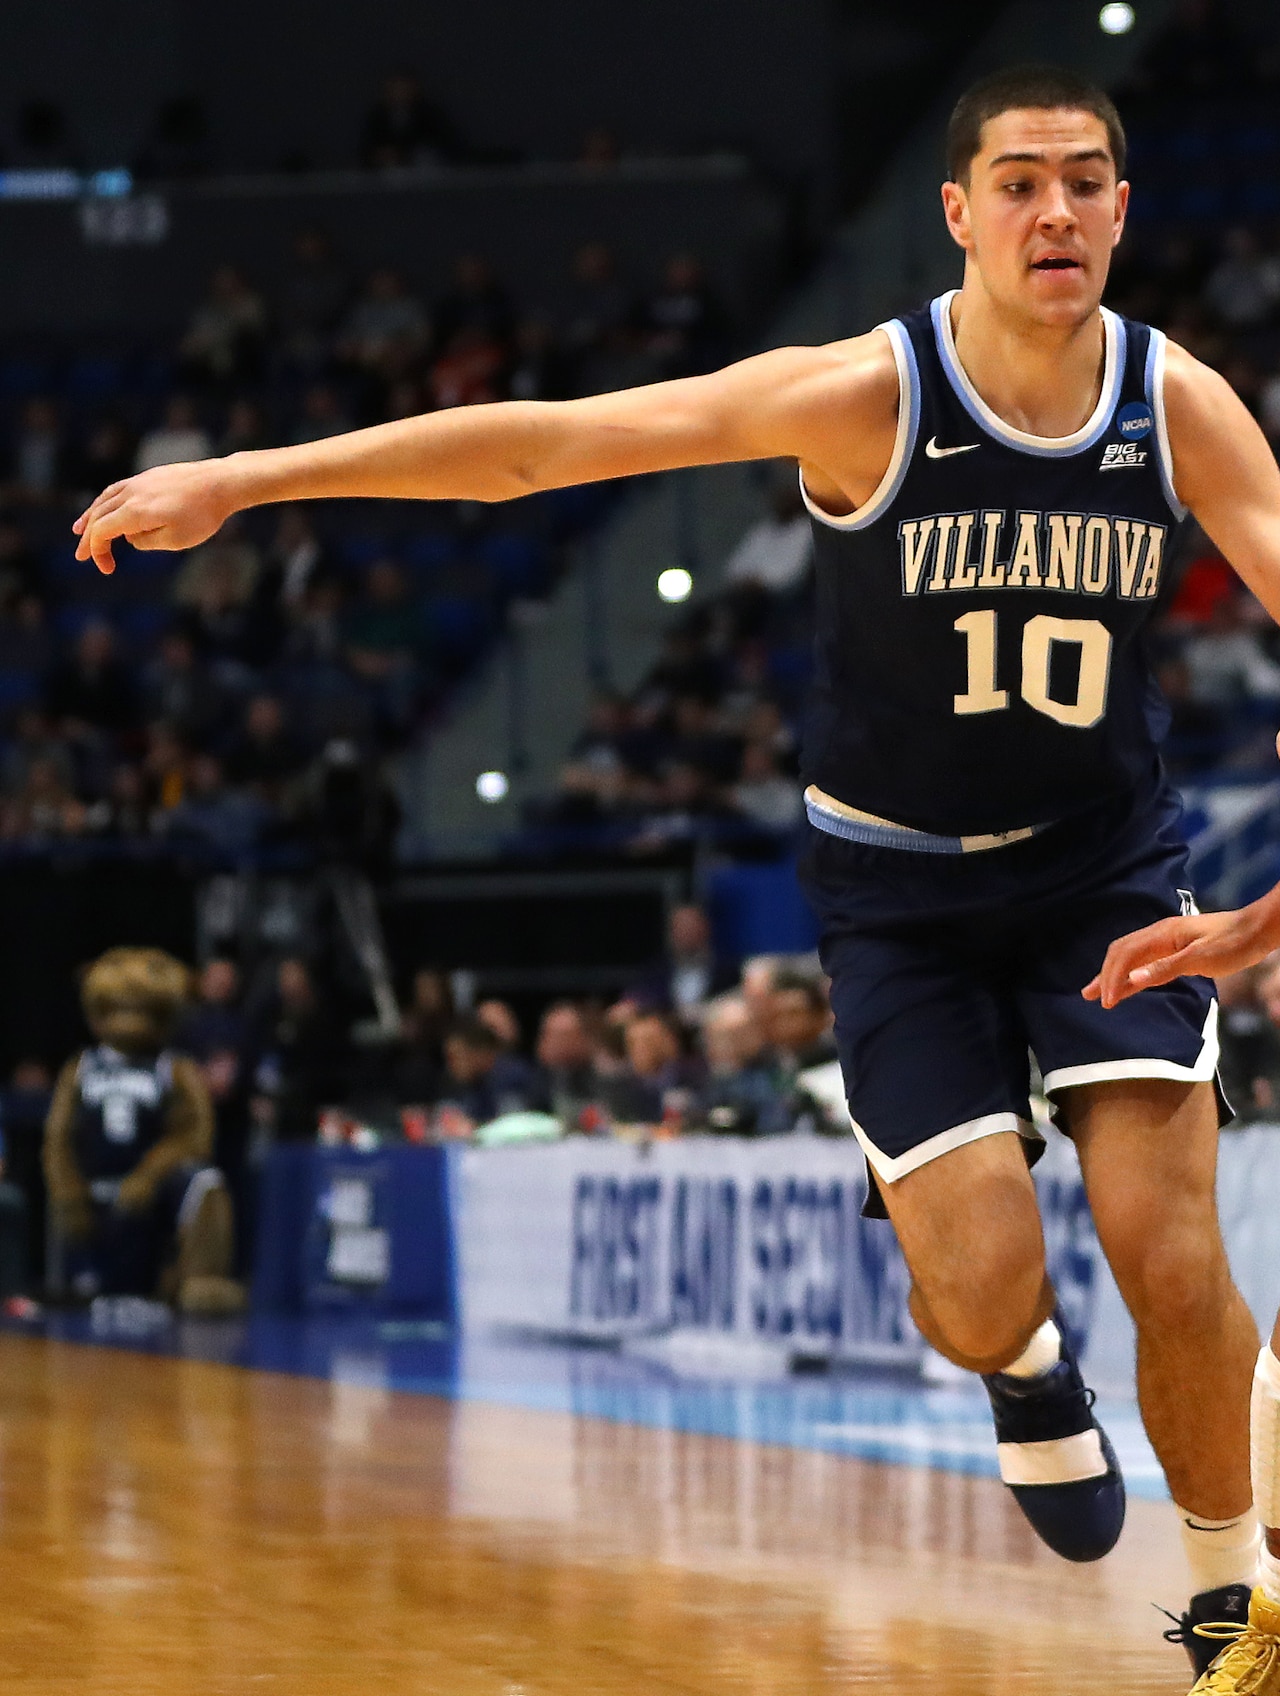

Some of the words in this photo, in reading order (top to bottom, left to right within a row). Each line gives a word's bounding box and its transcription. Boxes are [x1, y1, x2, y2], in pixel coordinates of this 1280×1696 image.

[1122, 417, 1151, 431] NCAA
[1104, 443, 1138, 454] BIG
[1101, 452, 1147, 464] EAST
[898, 509, 1168, 600] VILLANOVA
[953, 609, 1113, 729] 10
